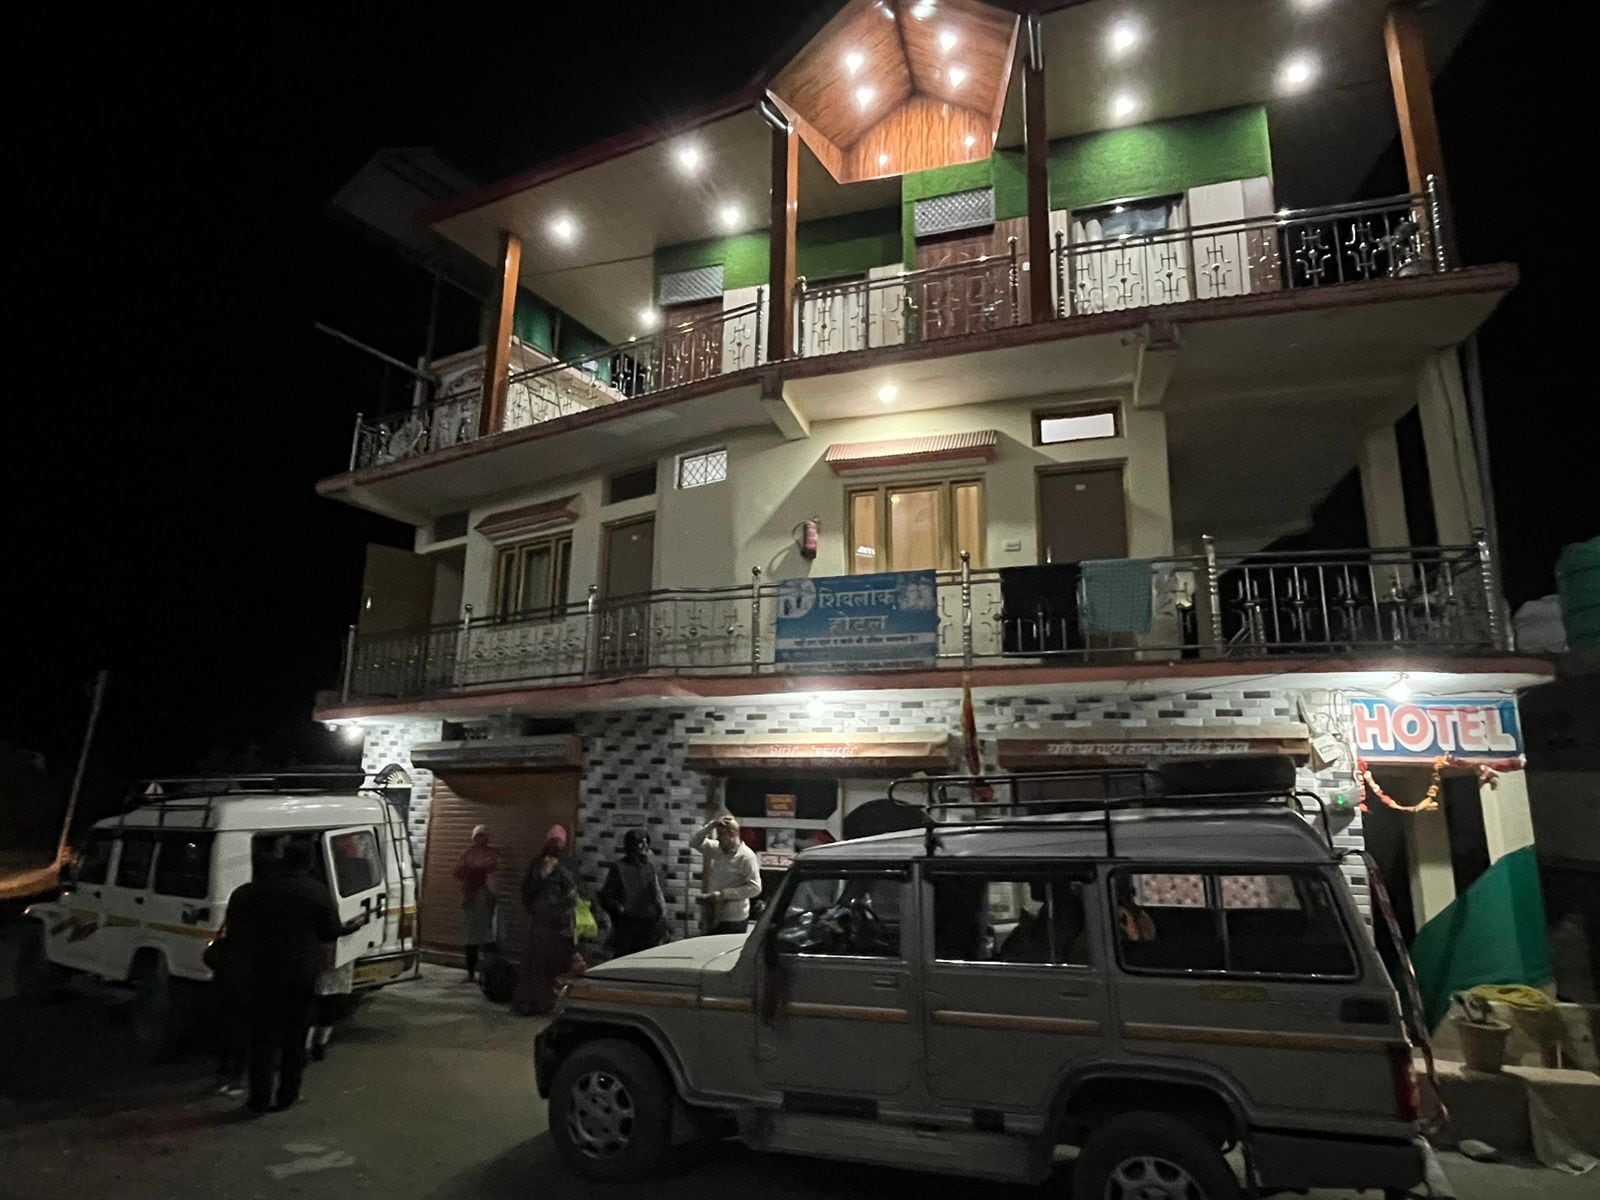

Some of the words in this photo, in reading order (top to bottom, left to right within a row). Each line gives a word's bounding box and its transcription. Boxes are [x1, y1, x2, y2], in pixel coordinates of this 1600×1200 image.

[818, 586, 896, 609] शिवलोक
[828, 611, 889, 633] होटल
[1354, 703, 1517, 752] HOTEL
